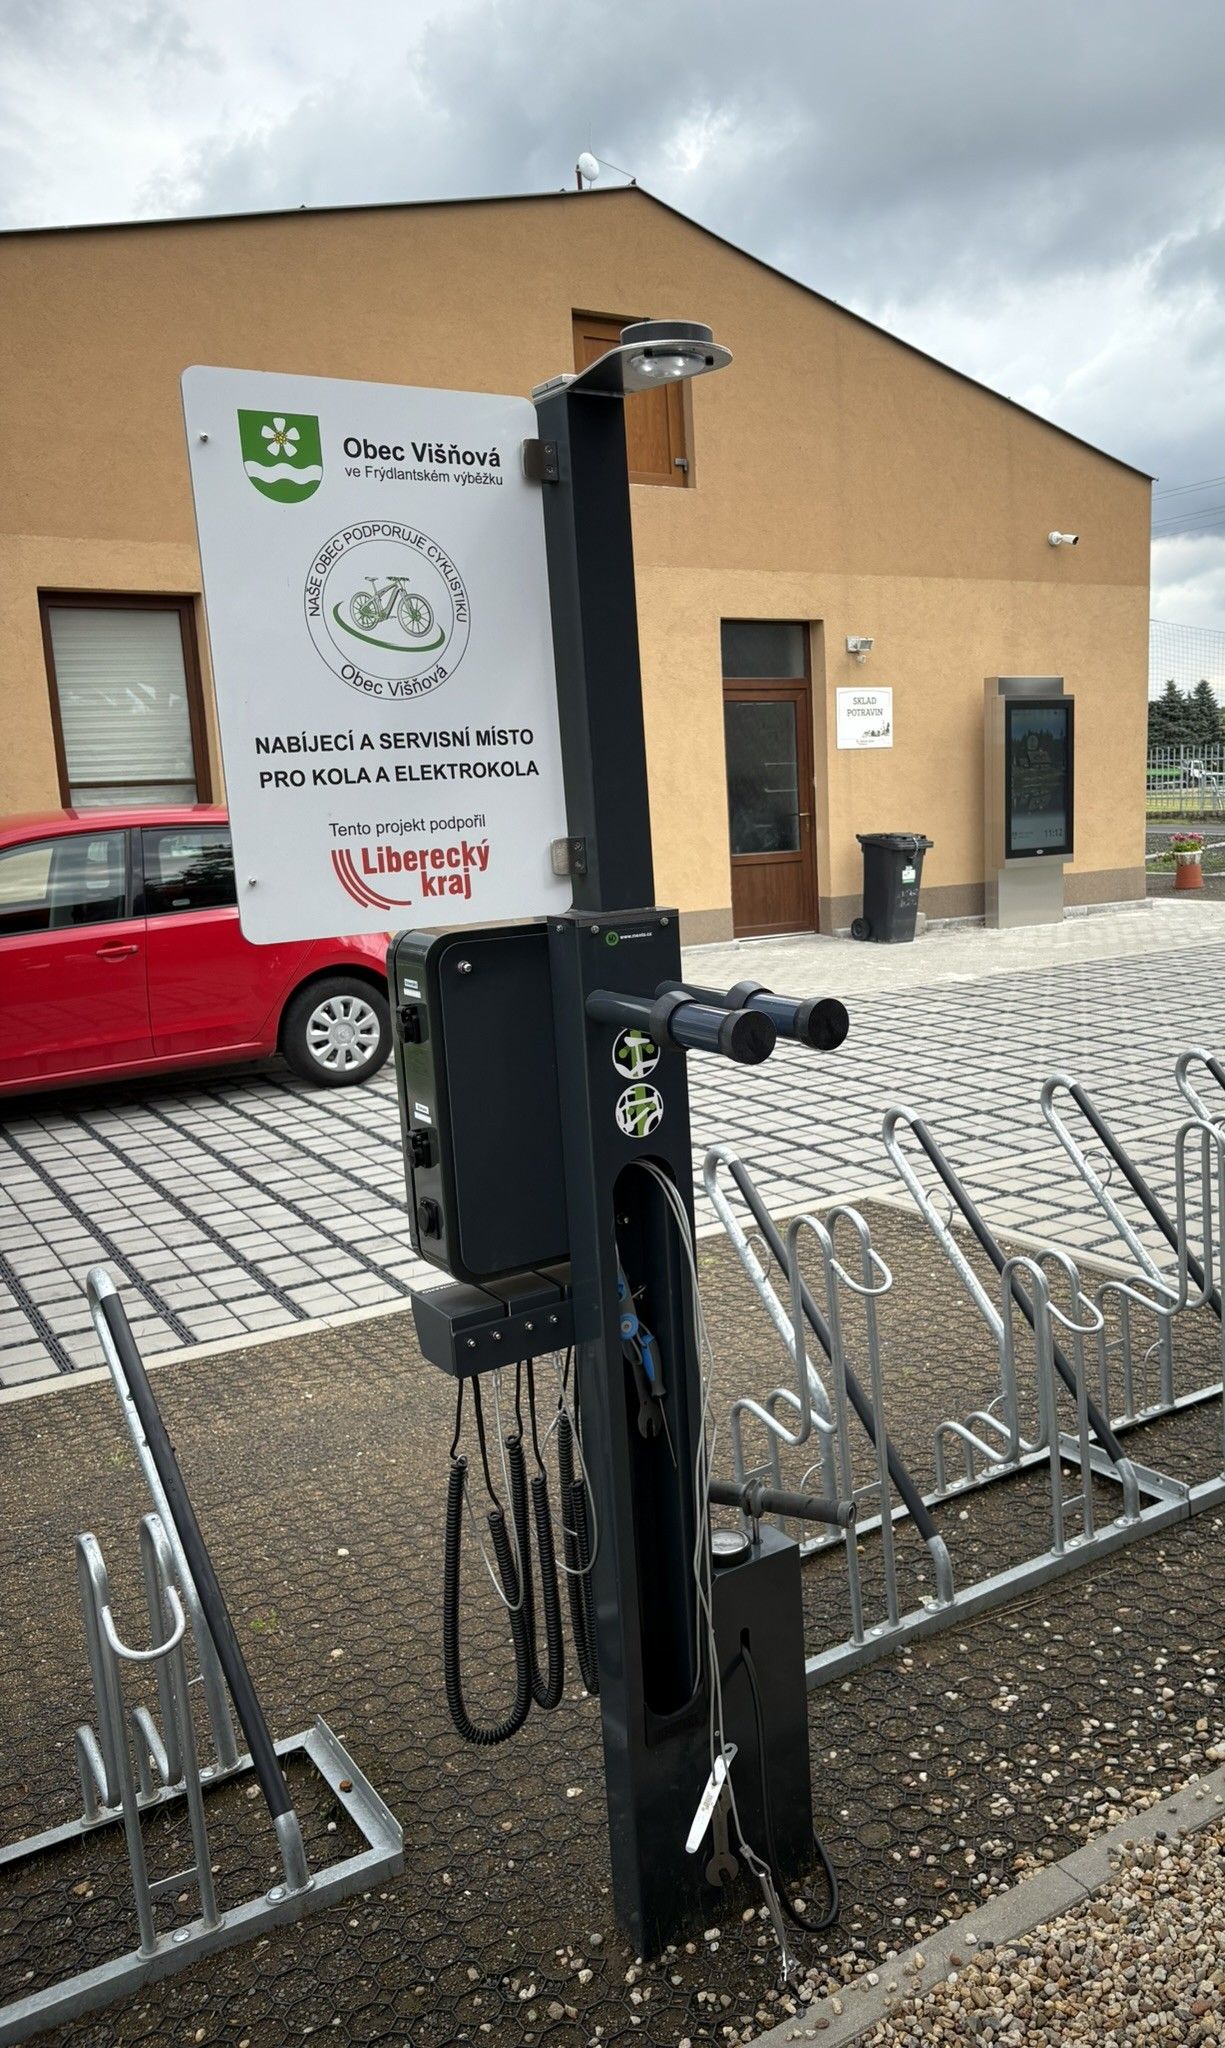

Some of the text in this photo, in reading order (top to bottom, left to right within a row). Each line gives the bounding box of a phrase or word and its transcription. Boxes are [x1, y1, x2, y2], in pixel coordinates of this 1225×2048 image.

[343, 437, 501, 467] Obec Višňová
[345, 466, 503, 486] ve Frýdlantském výběžku
[307, 524, 467, 623] NAŠE OBEC PODPORUJE CYKLISTIKU
[340, 664, 449, 696] Obec Višňová
[847, 708, 883, 716] POTRAVIN
[255, 726, 534, 754] NABÍJECÍ A SERVISNÍ MÍSTO
[259, 760, 539, 788] PRO KOLA A ELEKTROKOLA
[329, 815, 486, 837] Tento projekt podpořil
[362, 839, 489, 874] Liberecký
[422, 869, 472, 899] kraj
